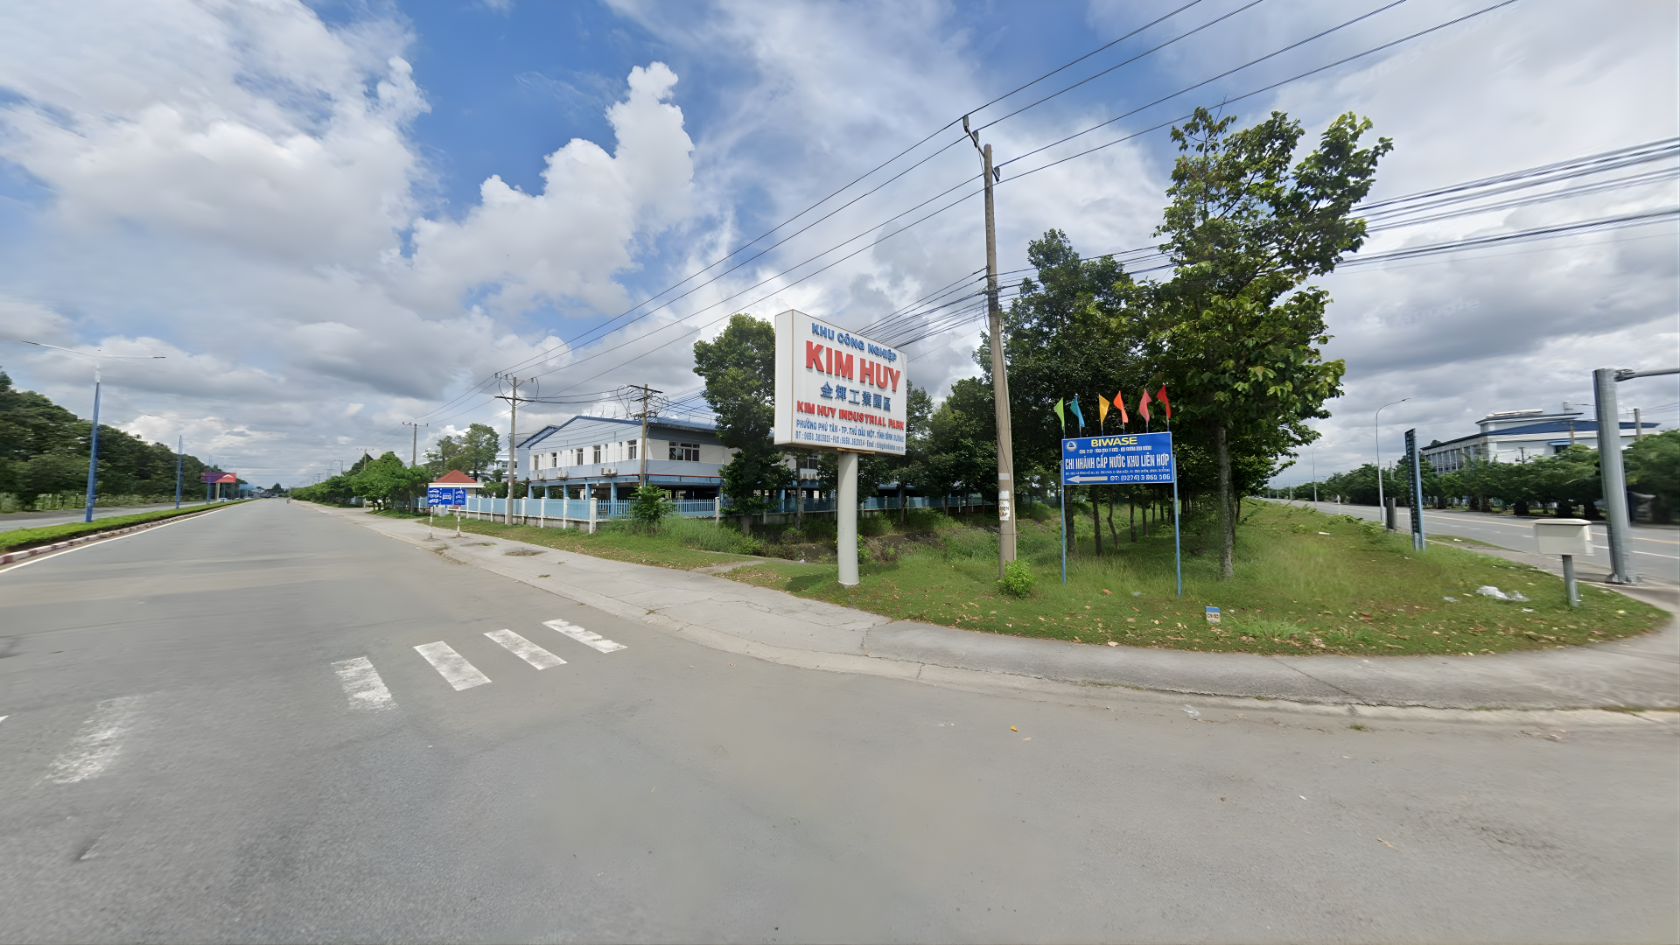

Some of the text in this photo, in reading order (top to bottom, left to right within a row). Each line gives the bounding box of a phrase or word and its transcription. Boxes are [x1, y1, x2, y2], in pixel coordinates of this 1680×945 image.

[811, 322, 897, 364] KHU CÔNG NGHIỆP
[806, 340, 901, 392] KIM HUY
[796, 400, 905, 431] KIM HUY INDUSTRIAL PARK
[1091, 436, 1138, 447] BIWASE
[1065, 458, 1075, 470] CHI
[1075, 455, 1095, 470] NHÁNH
[1096, 453, 1108, 469] CẤP
[1109, 453, 1126, 468] NƯỚC
[1126, 455, 1140, 468] KHU
[1141, 452, 1155, 467] LIÊN
